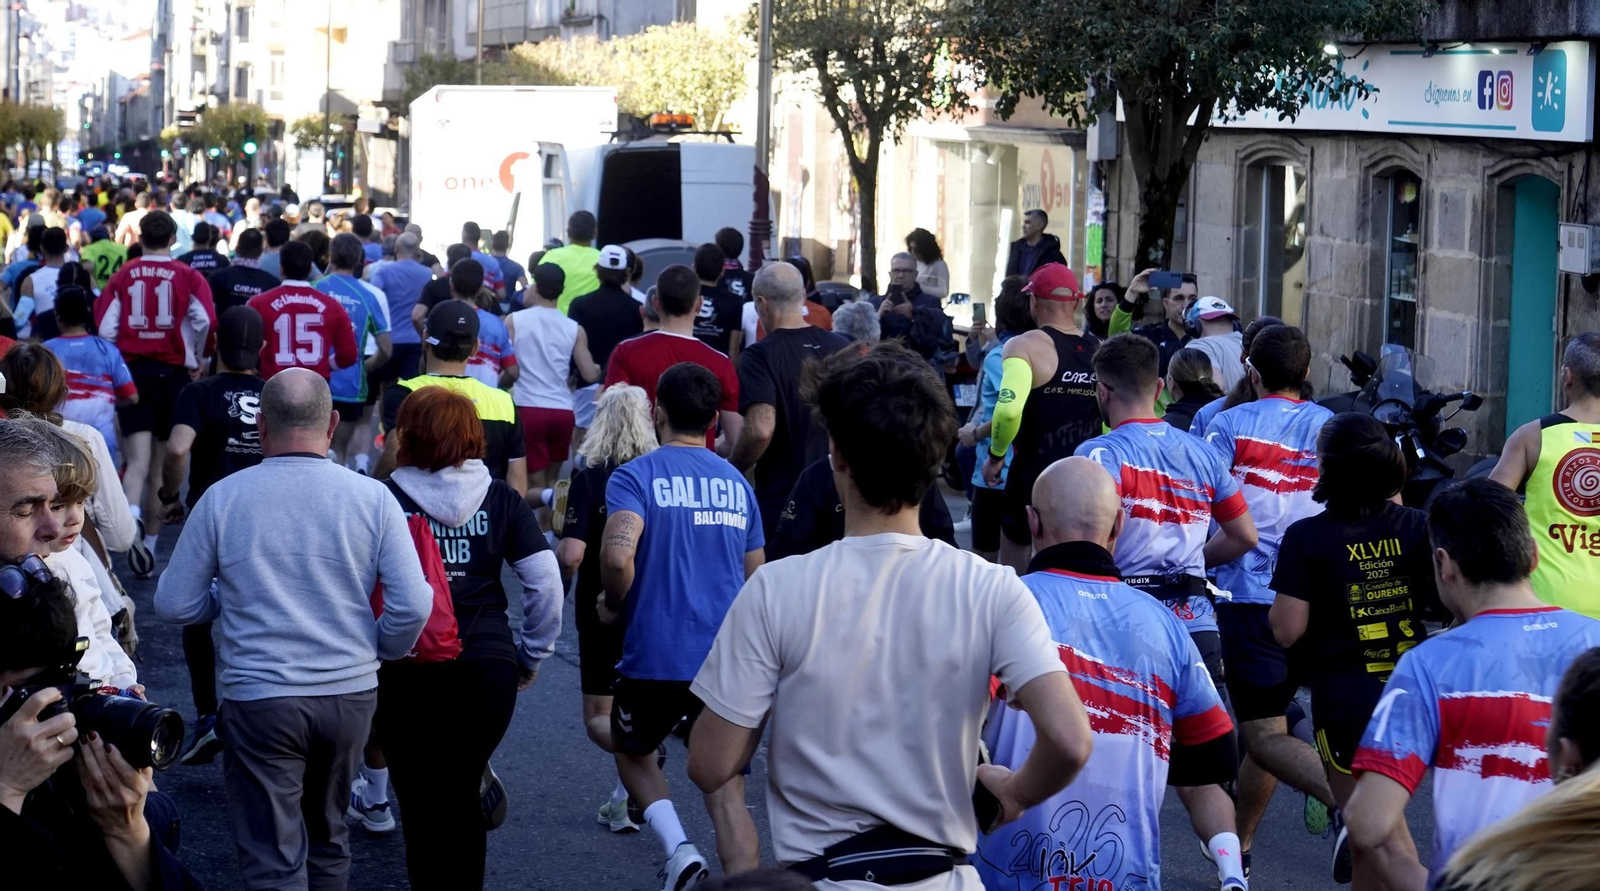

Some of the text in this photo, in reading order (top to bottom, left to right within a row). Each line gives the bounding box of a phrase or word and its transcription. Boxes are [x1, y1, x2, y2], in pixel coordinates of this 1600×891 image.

[1462, 88, 1473, 103] en
[97, 255, 123, 280] 24
[127, 279, 174, 330] 11
[273, 313, 324, 366] 15
[652, 476, 747, 514] GALICIA
[436, 538, 472, 564] LUB
[1346, 538, 1402, 562] XLVIII
[1359, 559, 1394, 571] Edición
[1366, 569, 1390, 580] 2025
[1366, 585, 1409, 600] OURENSE
